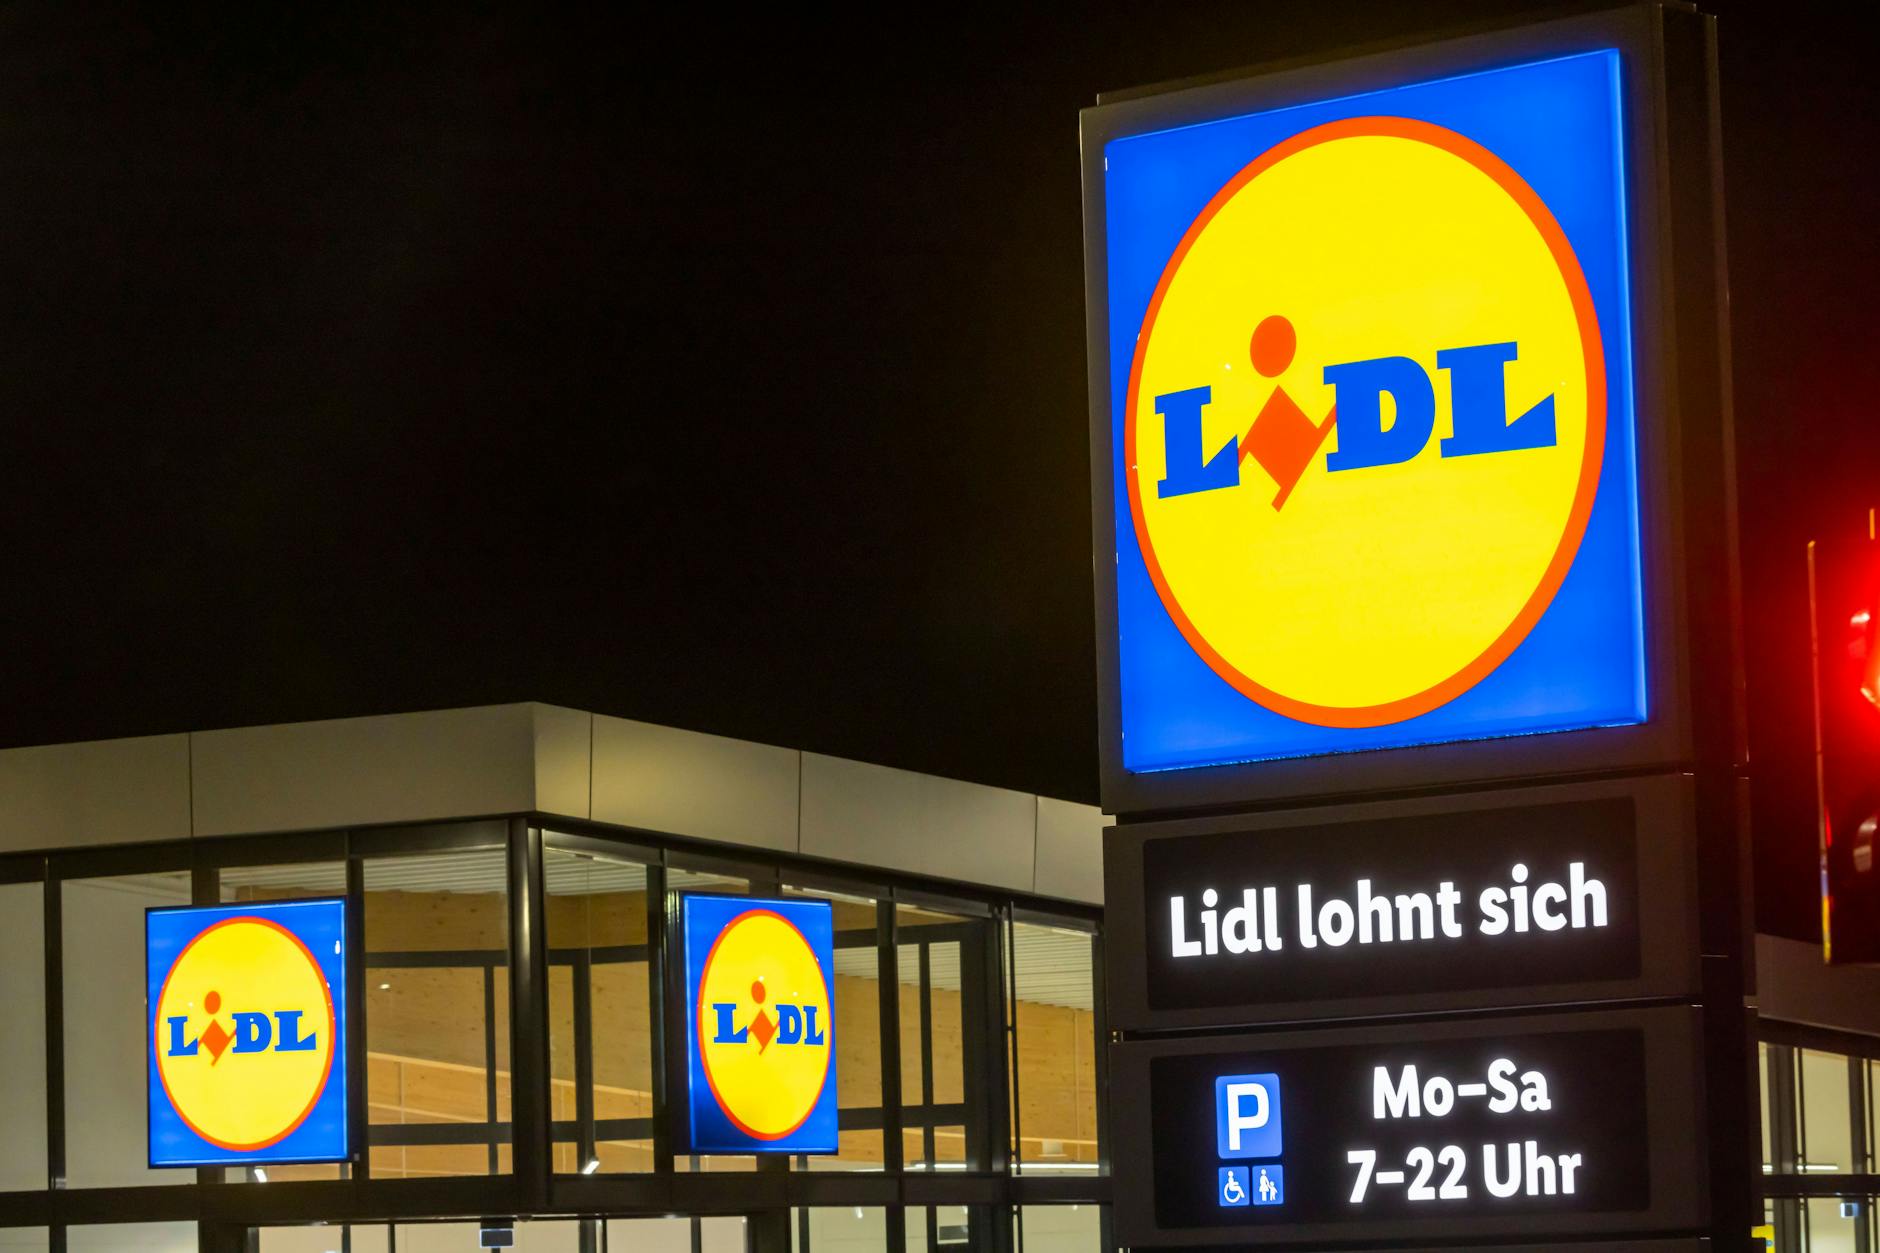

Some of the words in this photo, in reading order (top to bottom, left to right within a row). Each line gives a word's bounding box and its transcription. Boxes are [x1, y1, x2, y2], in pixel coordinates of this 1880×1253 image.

[1170, 886, 1283, 958] Lidl
[1297, 878, 1463, 949] lohnt
[1478, 861, 1608, 936] sich
[1226, 1082, 1271, 1151] P
[1482, 1140, 1583, 1199] Uhr
